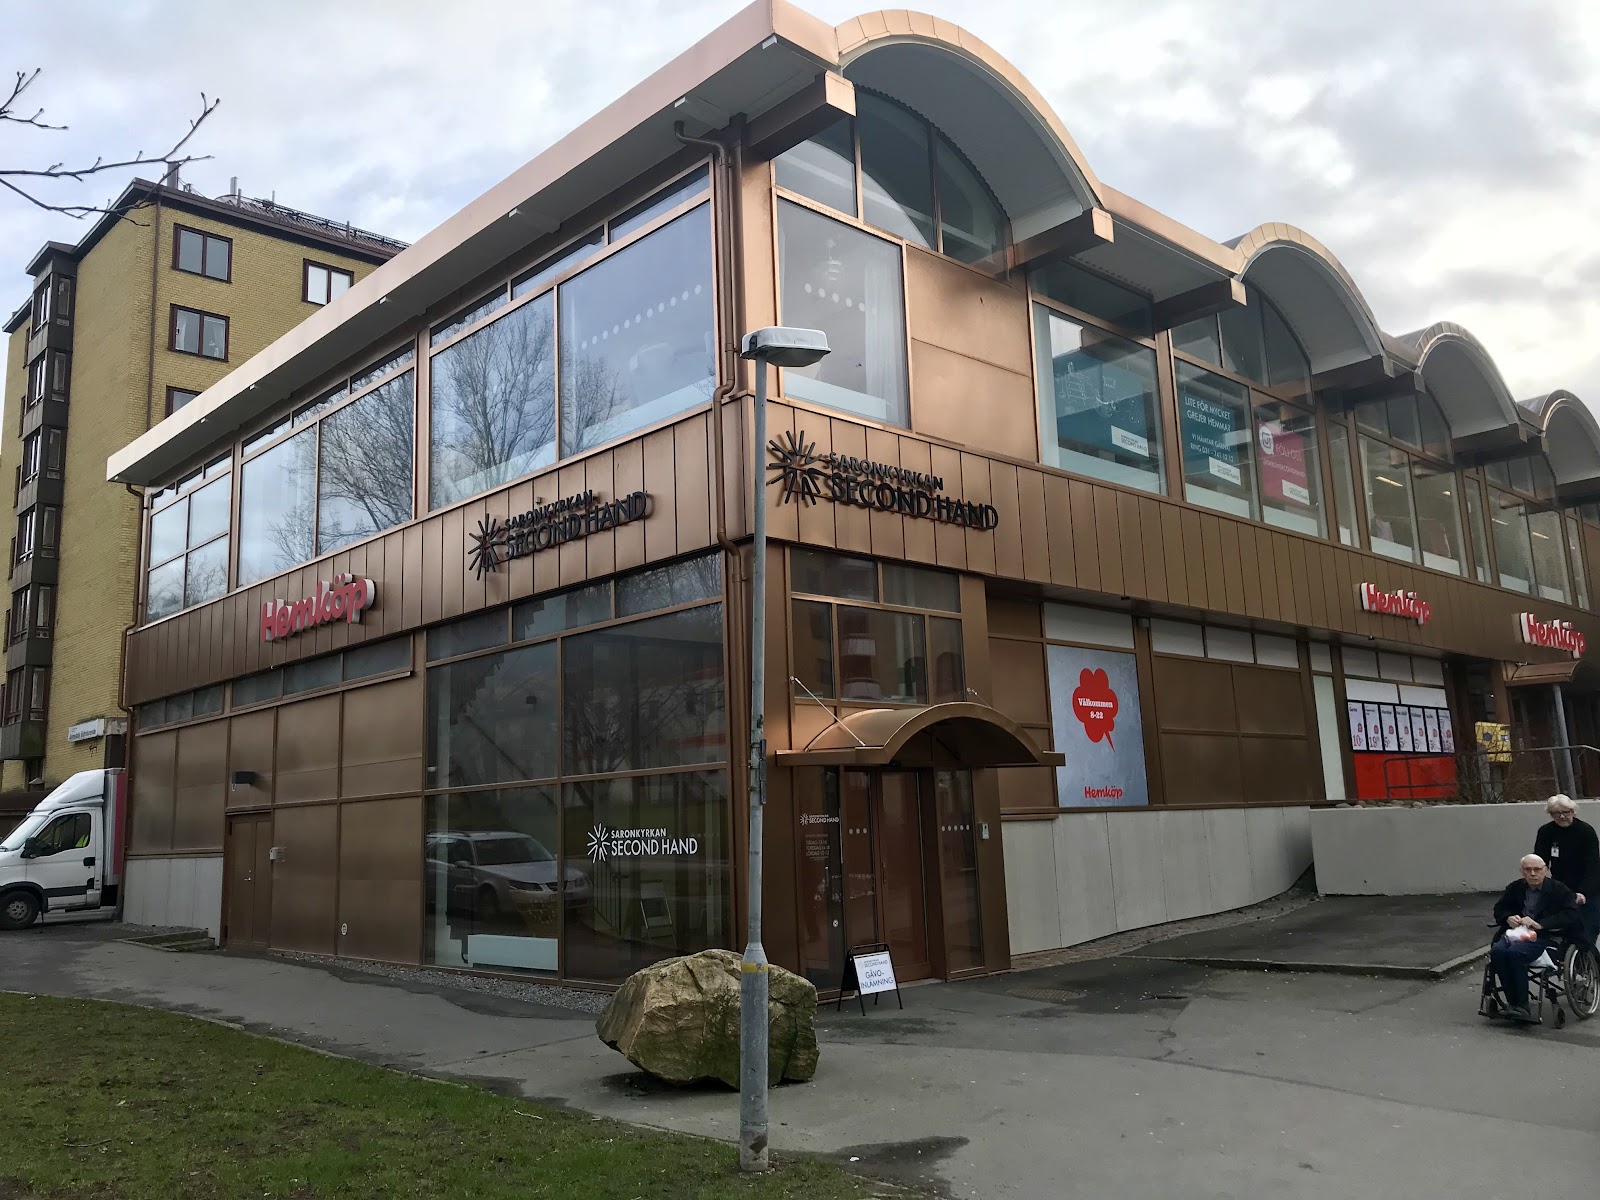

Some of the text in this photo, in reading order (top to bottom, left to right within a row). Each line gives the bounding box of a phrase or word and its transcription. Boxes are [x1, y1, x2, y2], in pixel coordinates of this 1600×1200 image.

[1187, 410, 1206, 422] GREJER
[830, 452, 943, 490] SARONKYRKAN
[505, 490, 593, 530] SARONKYRKAN
[832, 472, 998, 530] SECOND HAND
[505, 491, 647, 559] SECOND HAND
[261, 573, 371, 643] Hemköp
[1361, 582, 1431, 624] Hemköp
[1520, 612, 1586, 658] Hemköp
[1078, 698, 1113, 708] Välkommen
[1090, 711, 1103, 719] 8-22
[1084, 785, 1122, 799] Hemköp
[611, 828, 666, 838] SARONKYRKAN
[611, 838, 698, 856] SECOND HAND
[861, 977, 893, 989] INLÄMNING
